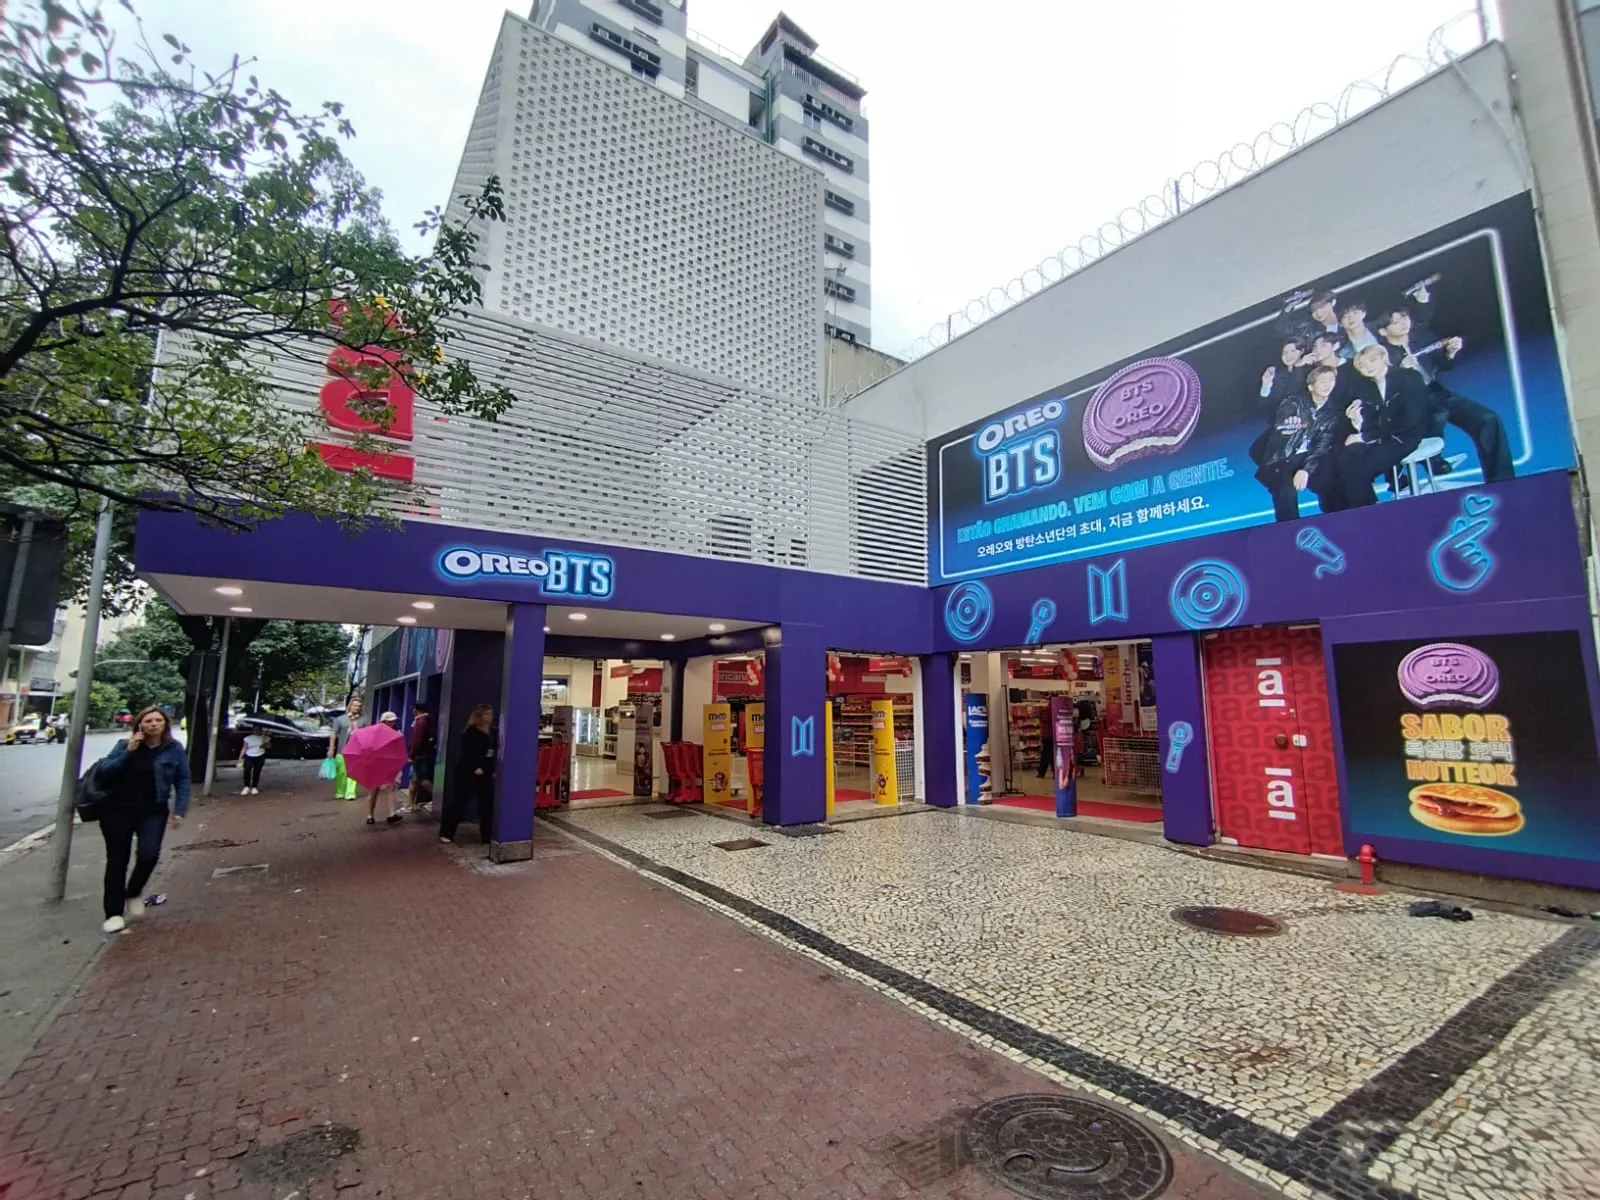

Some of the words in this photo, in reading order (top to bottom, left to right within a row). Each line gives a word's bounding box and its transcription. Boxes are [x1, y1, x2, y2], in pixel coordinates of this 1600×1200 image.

[1119, 380, 1153, 401] BTS
[977, 401, 1063, 451] OREO
[1111, 403, 1164, 429] OREO
[988, 434, 1056, 500] BTS
[1073, 489, 1107, 514] VEM
[1110, 478, 1149, 505] COM
[1152, 475, 1166, 496] A
[976, 539, 1014, 558] 오레오와
[1015, 524, 1077, 550] 방탄소년단의
[1079, 518, 1107, 536] 초대,
[1109, 511, 1133, 529] 지금
[1136, 495, 1210, 523] 함께하세요.
[444, 550, 549, 577] OREO
[547, 554, 611, 595] BTS
[1431, 658, 1461, 668] BTS
[1425, 673, 1469, 684] OREO
[1400, 713, 1513, 742] SABOR
[1405, 759, 1518, 787] HOTTEOK
